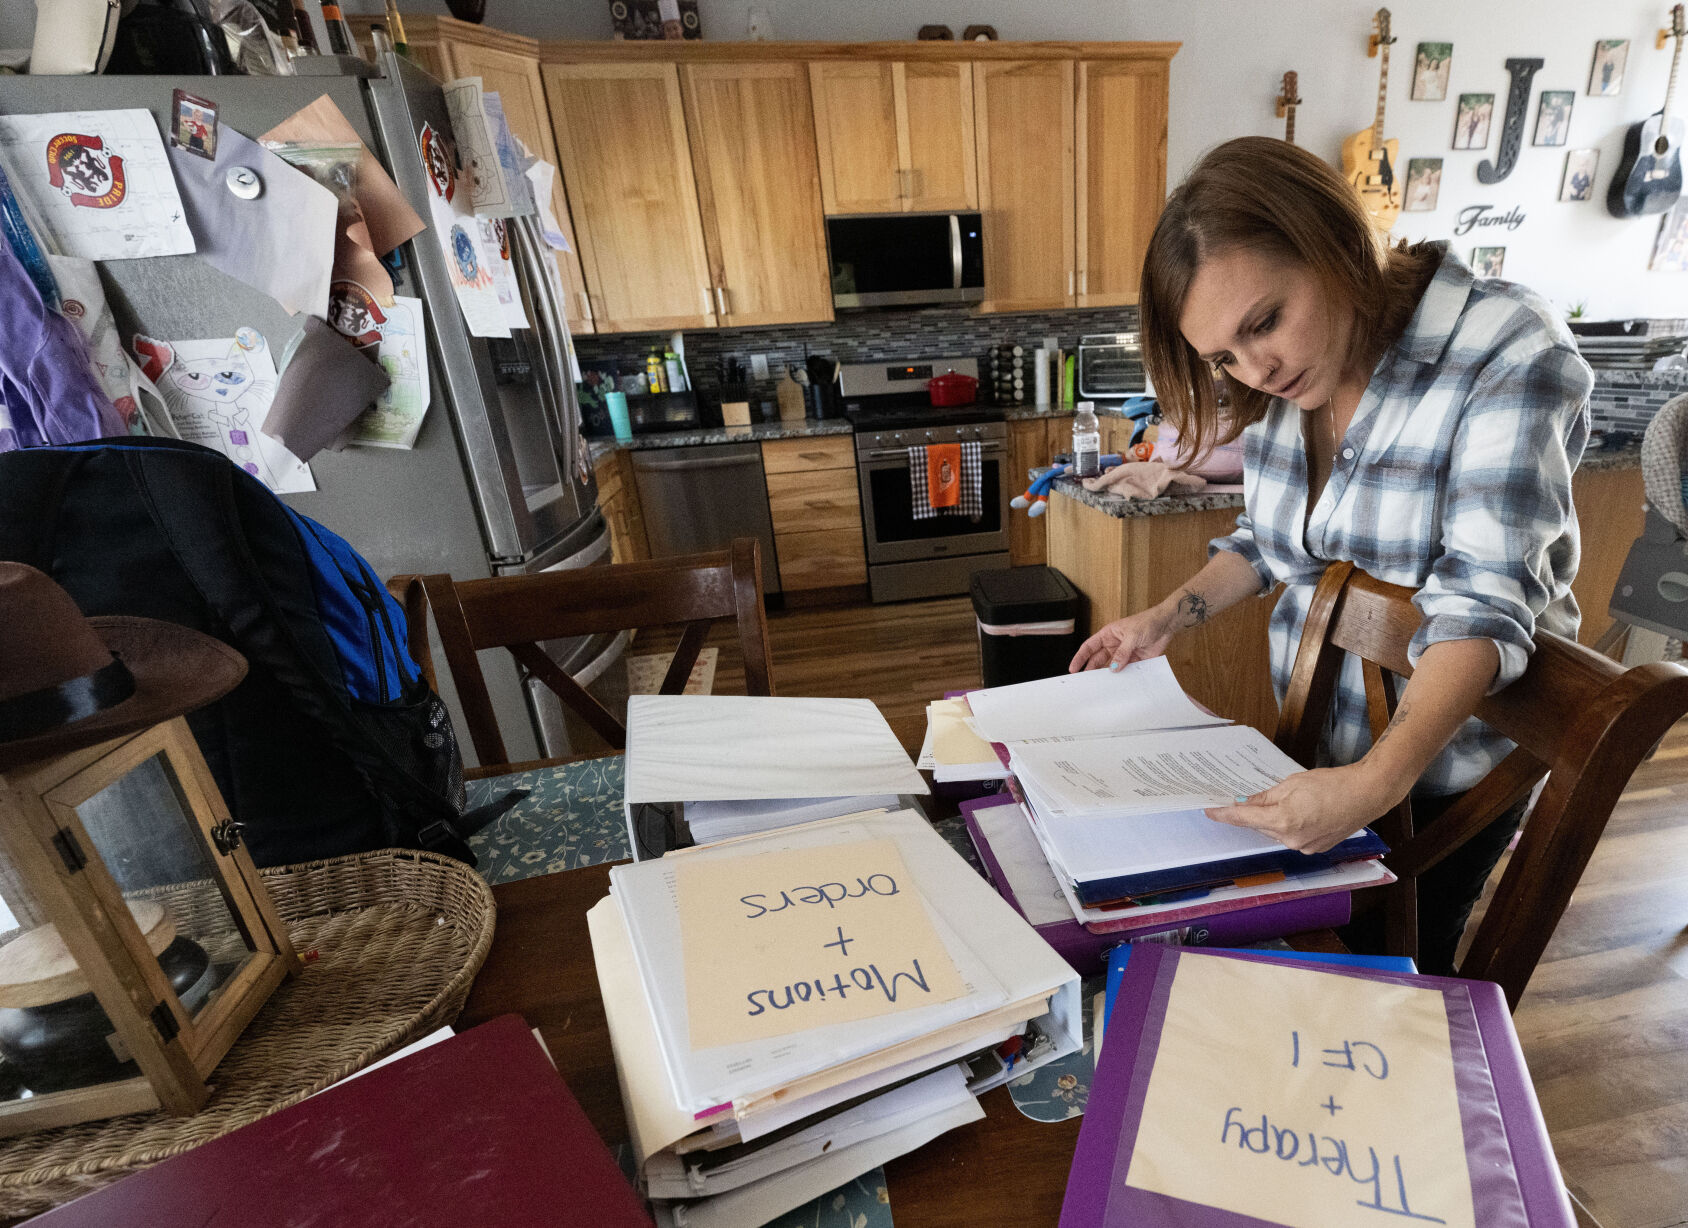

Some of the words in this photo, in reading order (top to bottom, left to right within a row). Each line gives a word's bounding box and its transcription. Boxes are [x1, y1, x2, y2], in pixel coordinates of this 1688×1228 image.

[54, 135, 77, 147] Soccer
[1477, 58, 1545, 184] J
[98, 181, 123, 207] PRIDE
[1454, 205, 1526, 236] Family
[746, 958, 930, 1016] Motions
[1221, 1107, 1447, 1226] Therapy
